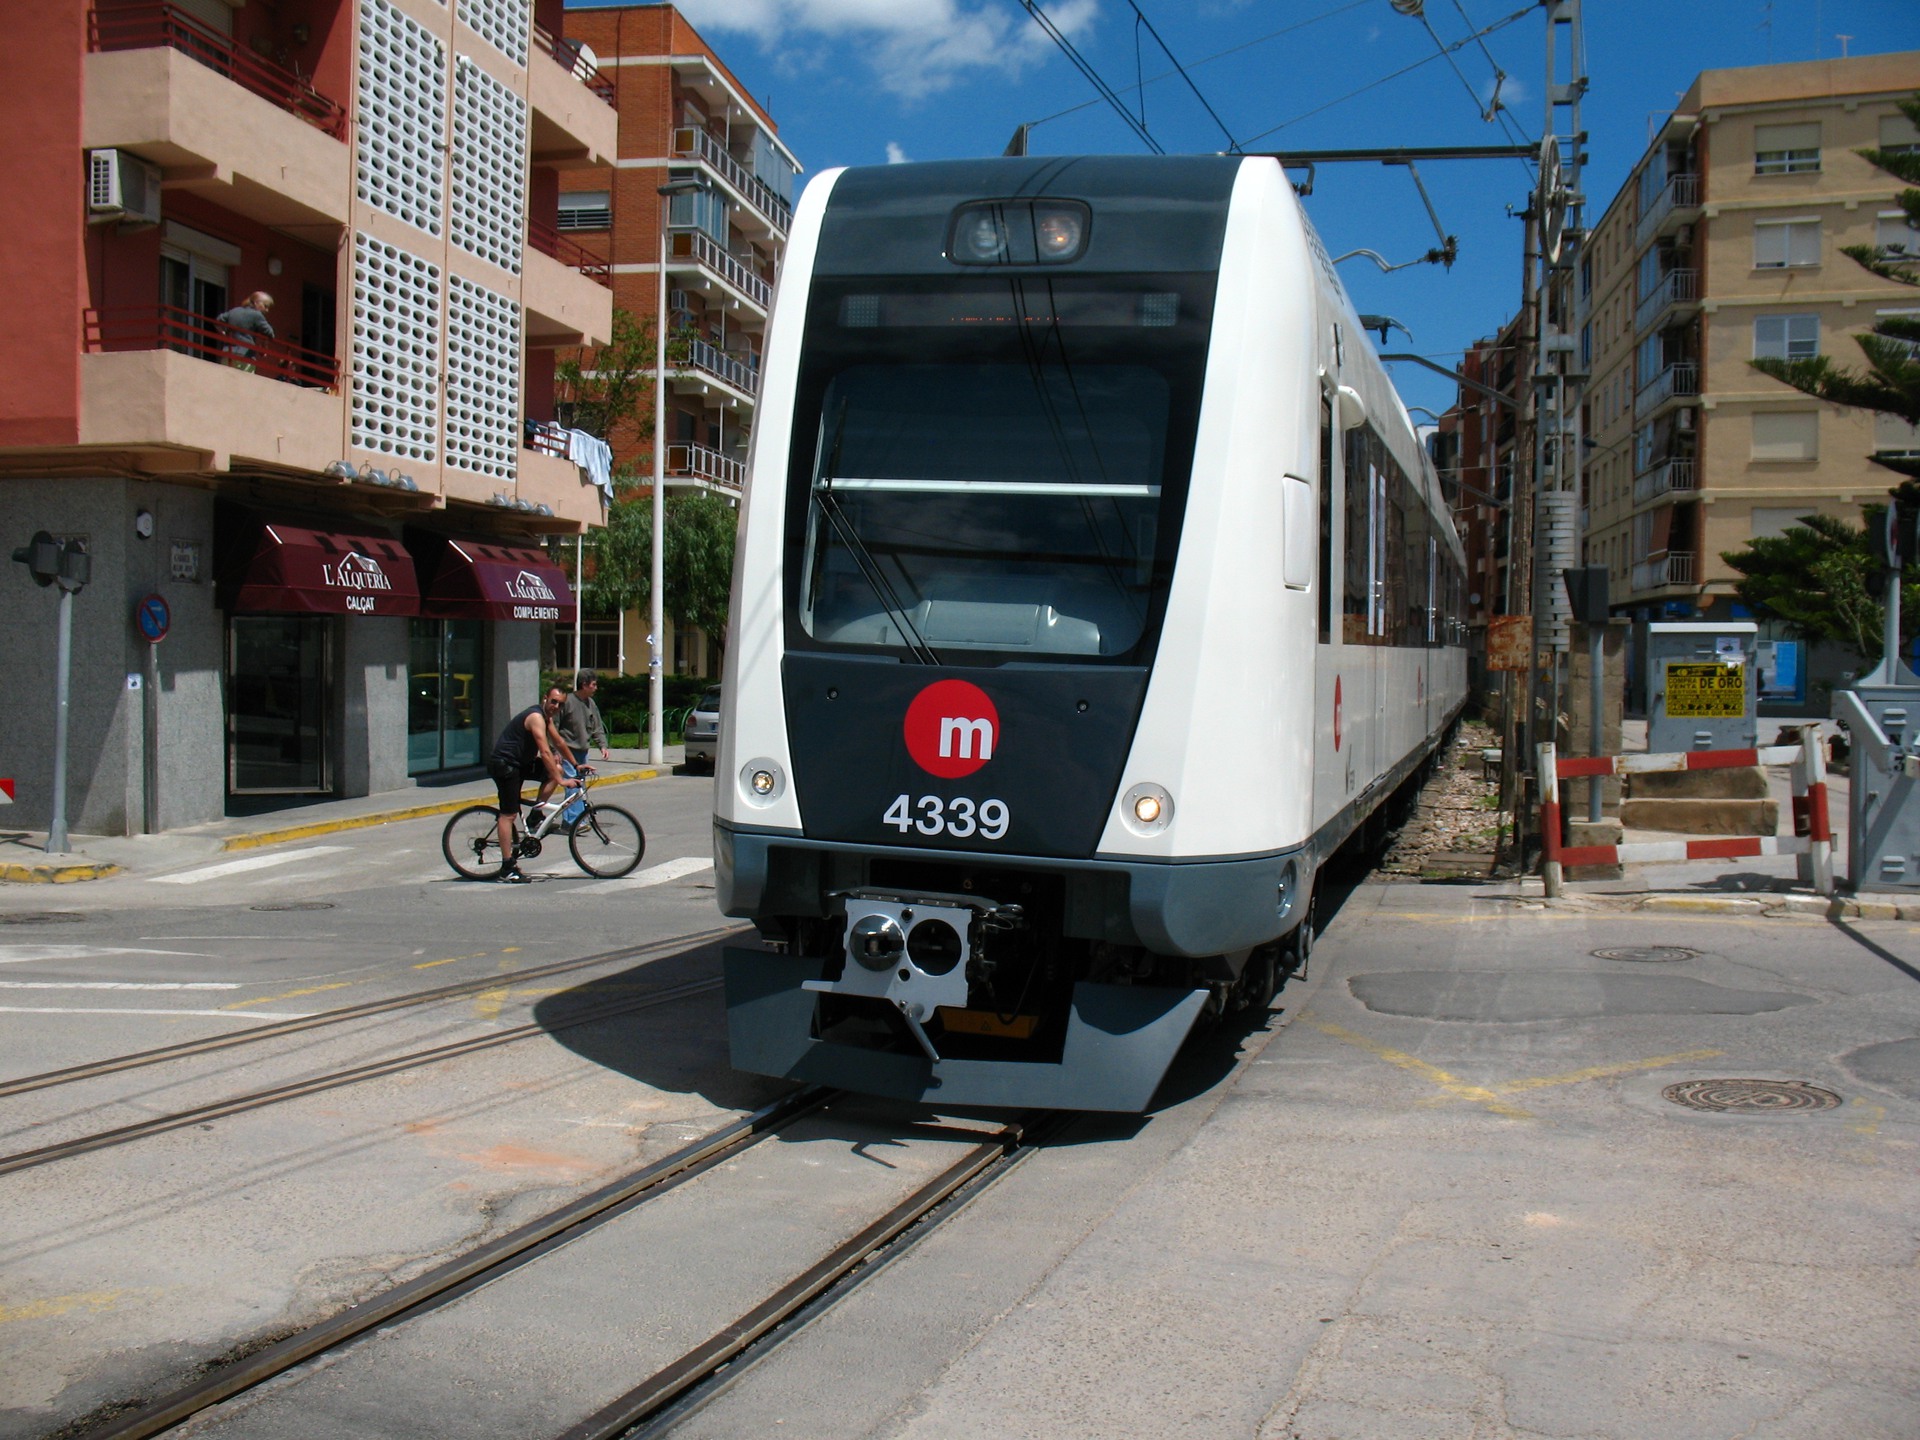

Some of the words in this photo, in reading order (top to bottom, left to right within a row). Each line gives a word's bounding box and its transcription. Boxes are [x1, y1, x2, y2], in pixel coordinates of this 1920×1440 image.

[346, 595, 375, 614] CALÇAT
[513, 605, 559, 620] COMPLEMENTS
[1700, 678, 1714, 689] DE
[1718, 677, 1743, 689] ORO
[938, 716, 994, 760] m
[882, 793, 1011, 841] 4339
